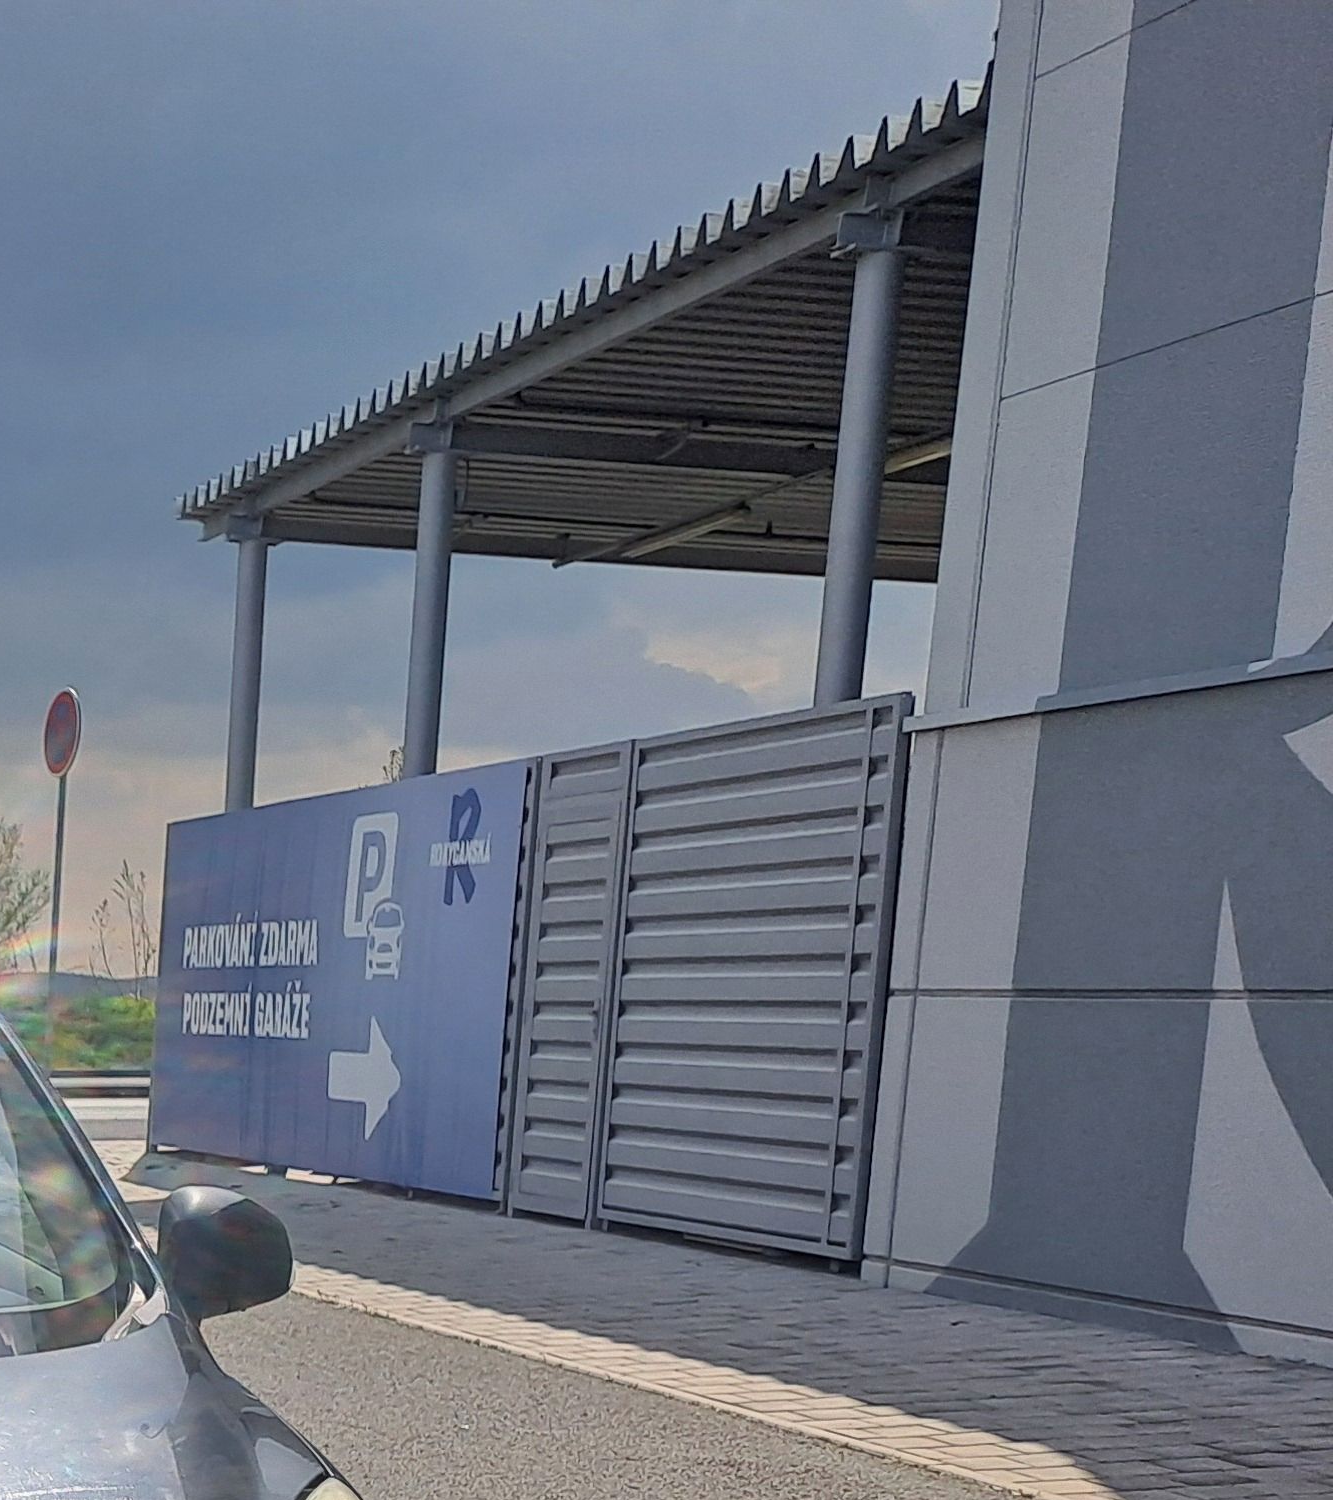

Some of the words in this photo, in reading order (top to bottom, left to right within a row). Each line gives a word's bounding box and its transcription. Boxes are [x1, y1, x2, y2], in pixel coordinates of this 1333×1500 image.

[355, 831, 387, 923] P
[183, 910, 259, 968] PARKOVÁNÍ
[259, 919, 318, 966] ZDARMA
[182, 981, 253, 1037] PODZEMNÍ
[254, 980, 311, 1040] GARÁŽE
